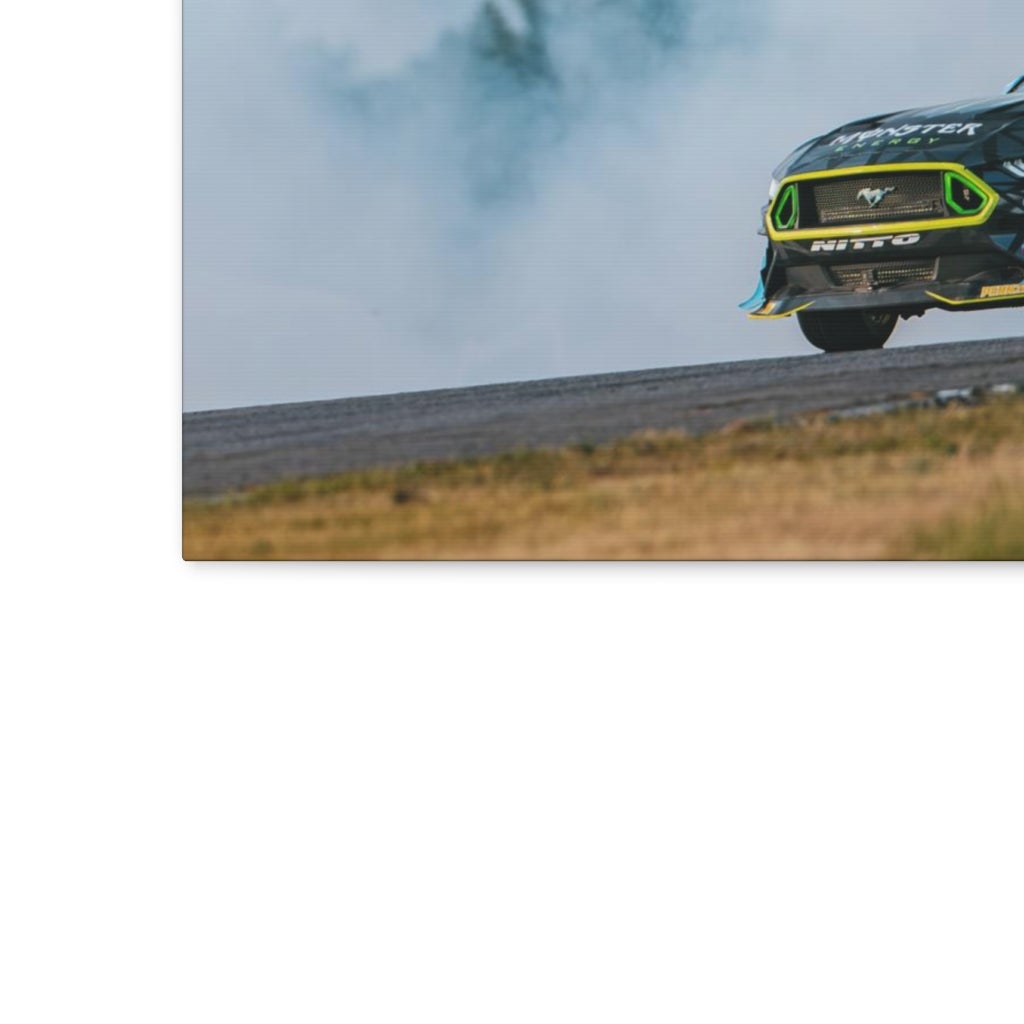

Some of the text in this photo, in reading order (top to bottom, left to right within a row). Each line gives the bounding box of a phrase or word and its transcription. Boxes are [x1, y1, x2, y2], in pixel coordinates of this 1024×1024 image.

[829, 122, 983, 147] MONSTER
[835, 137, 940, 153] ENERGY
[810, 232, 921, 253] NITTO
